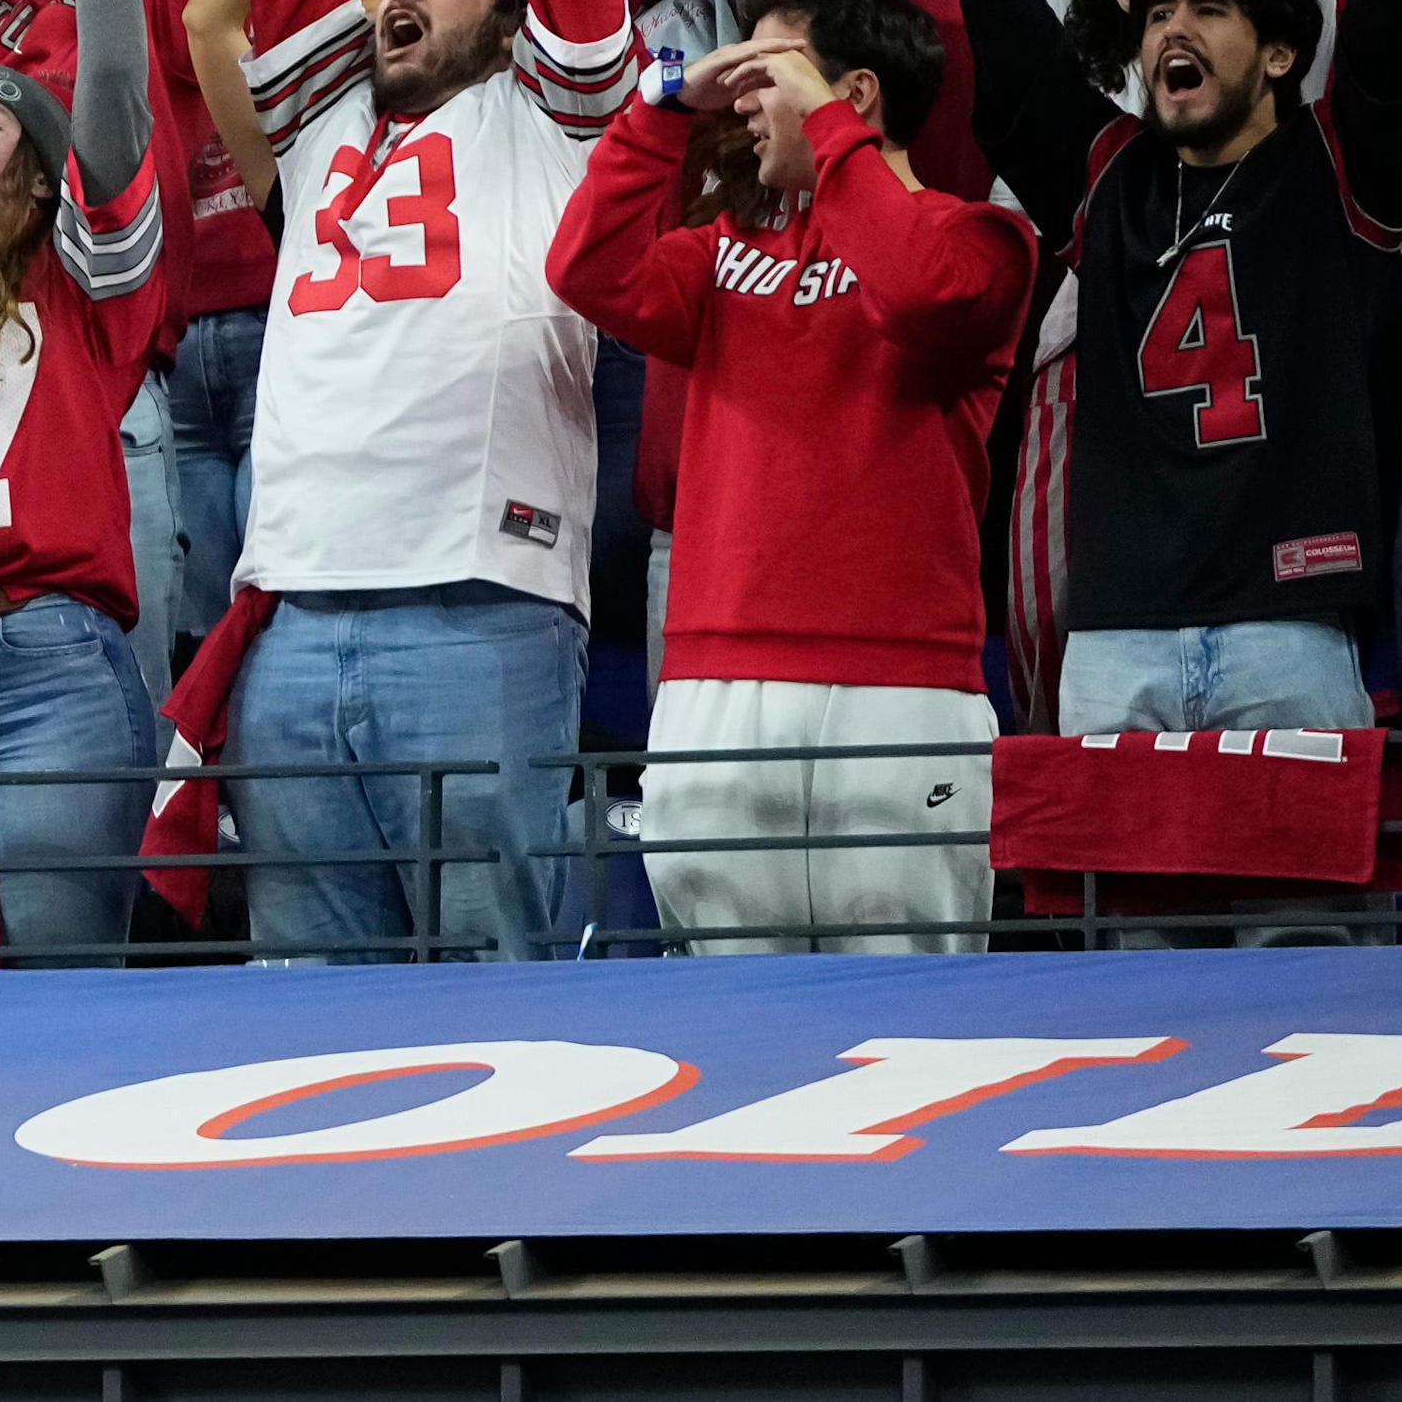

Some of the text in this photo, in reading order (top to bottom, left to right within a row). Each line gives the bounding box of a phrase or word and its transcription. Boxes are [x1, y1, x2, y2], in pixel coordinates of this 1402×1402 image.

[287, 132, 462, 318] 33
[1138, 238, 1268, 449] 4
[1305, 544, 1357, 558] COLOSSEUM
[932, 783, 953, 797] NIKE
